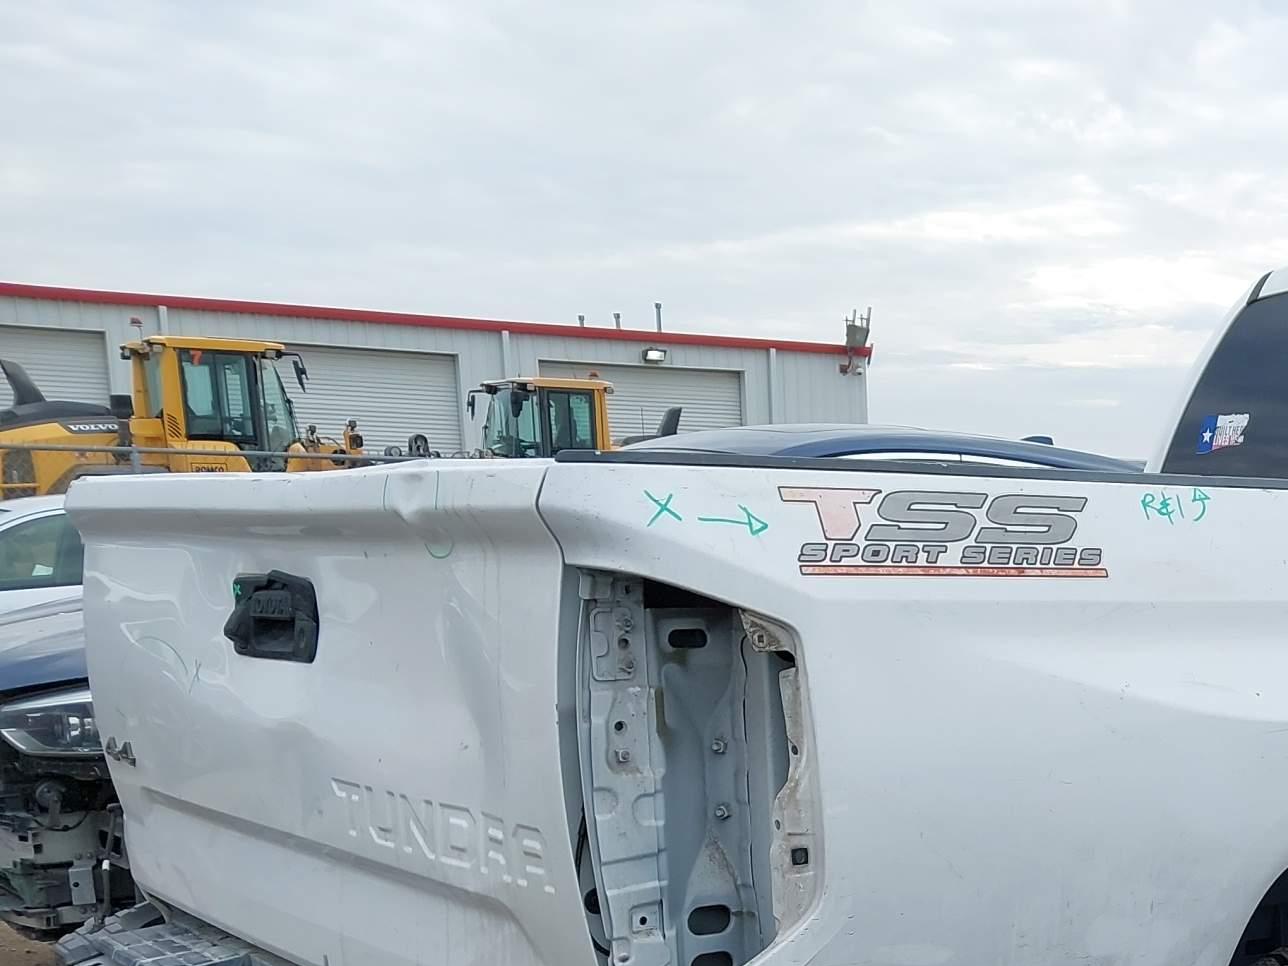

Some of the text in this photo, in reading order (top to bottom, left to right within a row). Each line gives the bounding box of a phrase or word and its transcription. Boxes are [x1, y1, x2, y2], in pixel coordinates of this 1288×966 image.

[68, 424, 119, 432] VOLVO
[778, 486, 1088, 545] TSS
[798, 542, 1102, 567] SPORT SERIES
[331, 777, 556, 895] TUNDRA
